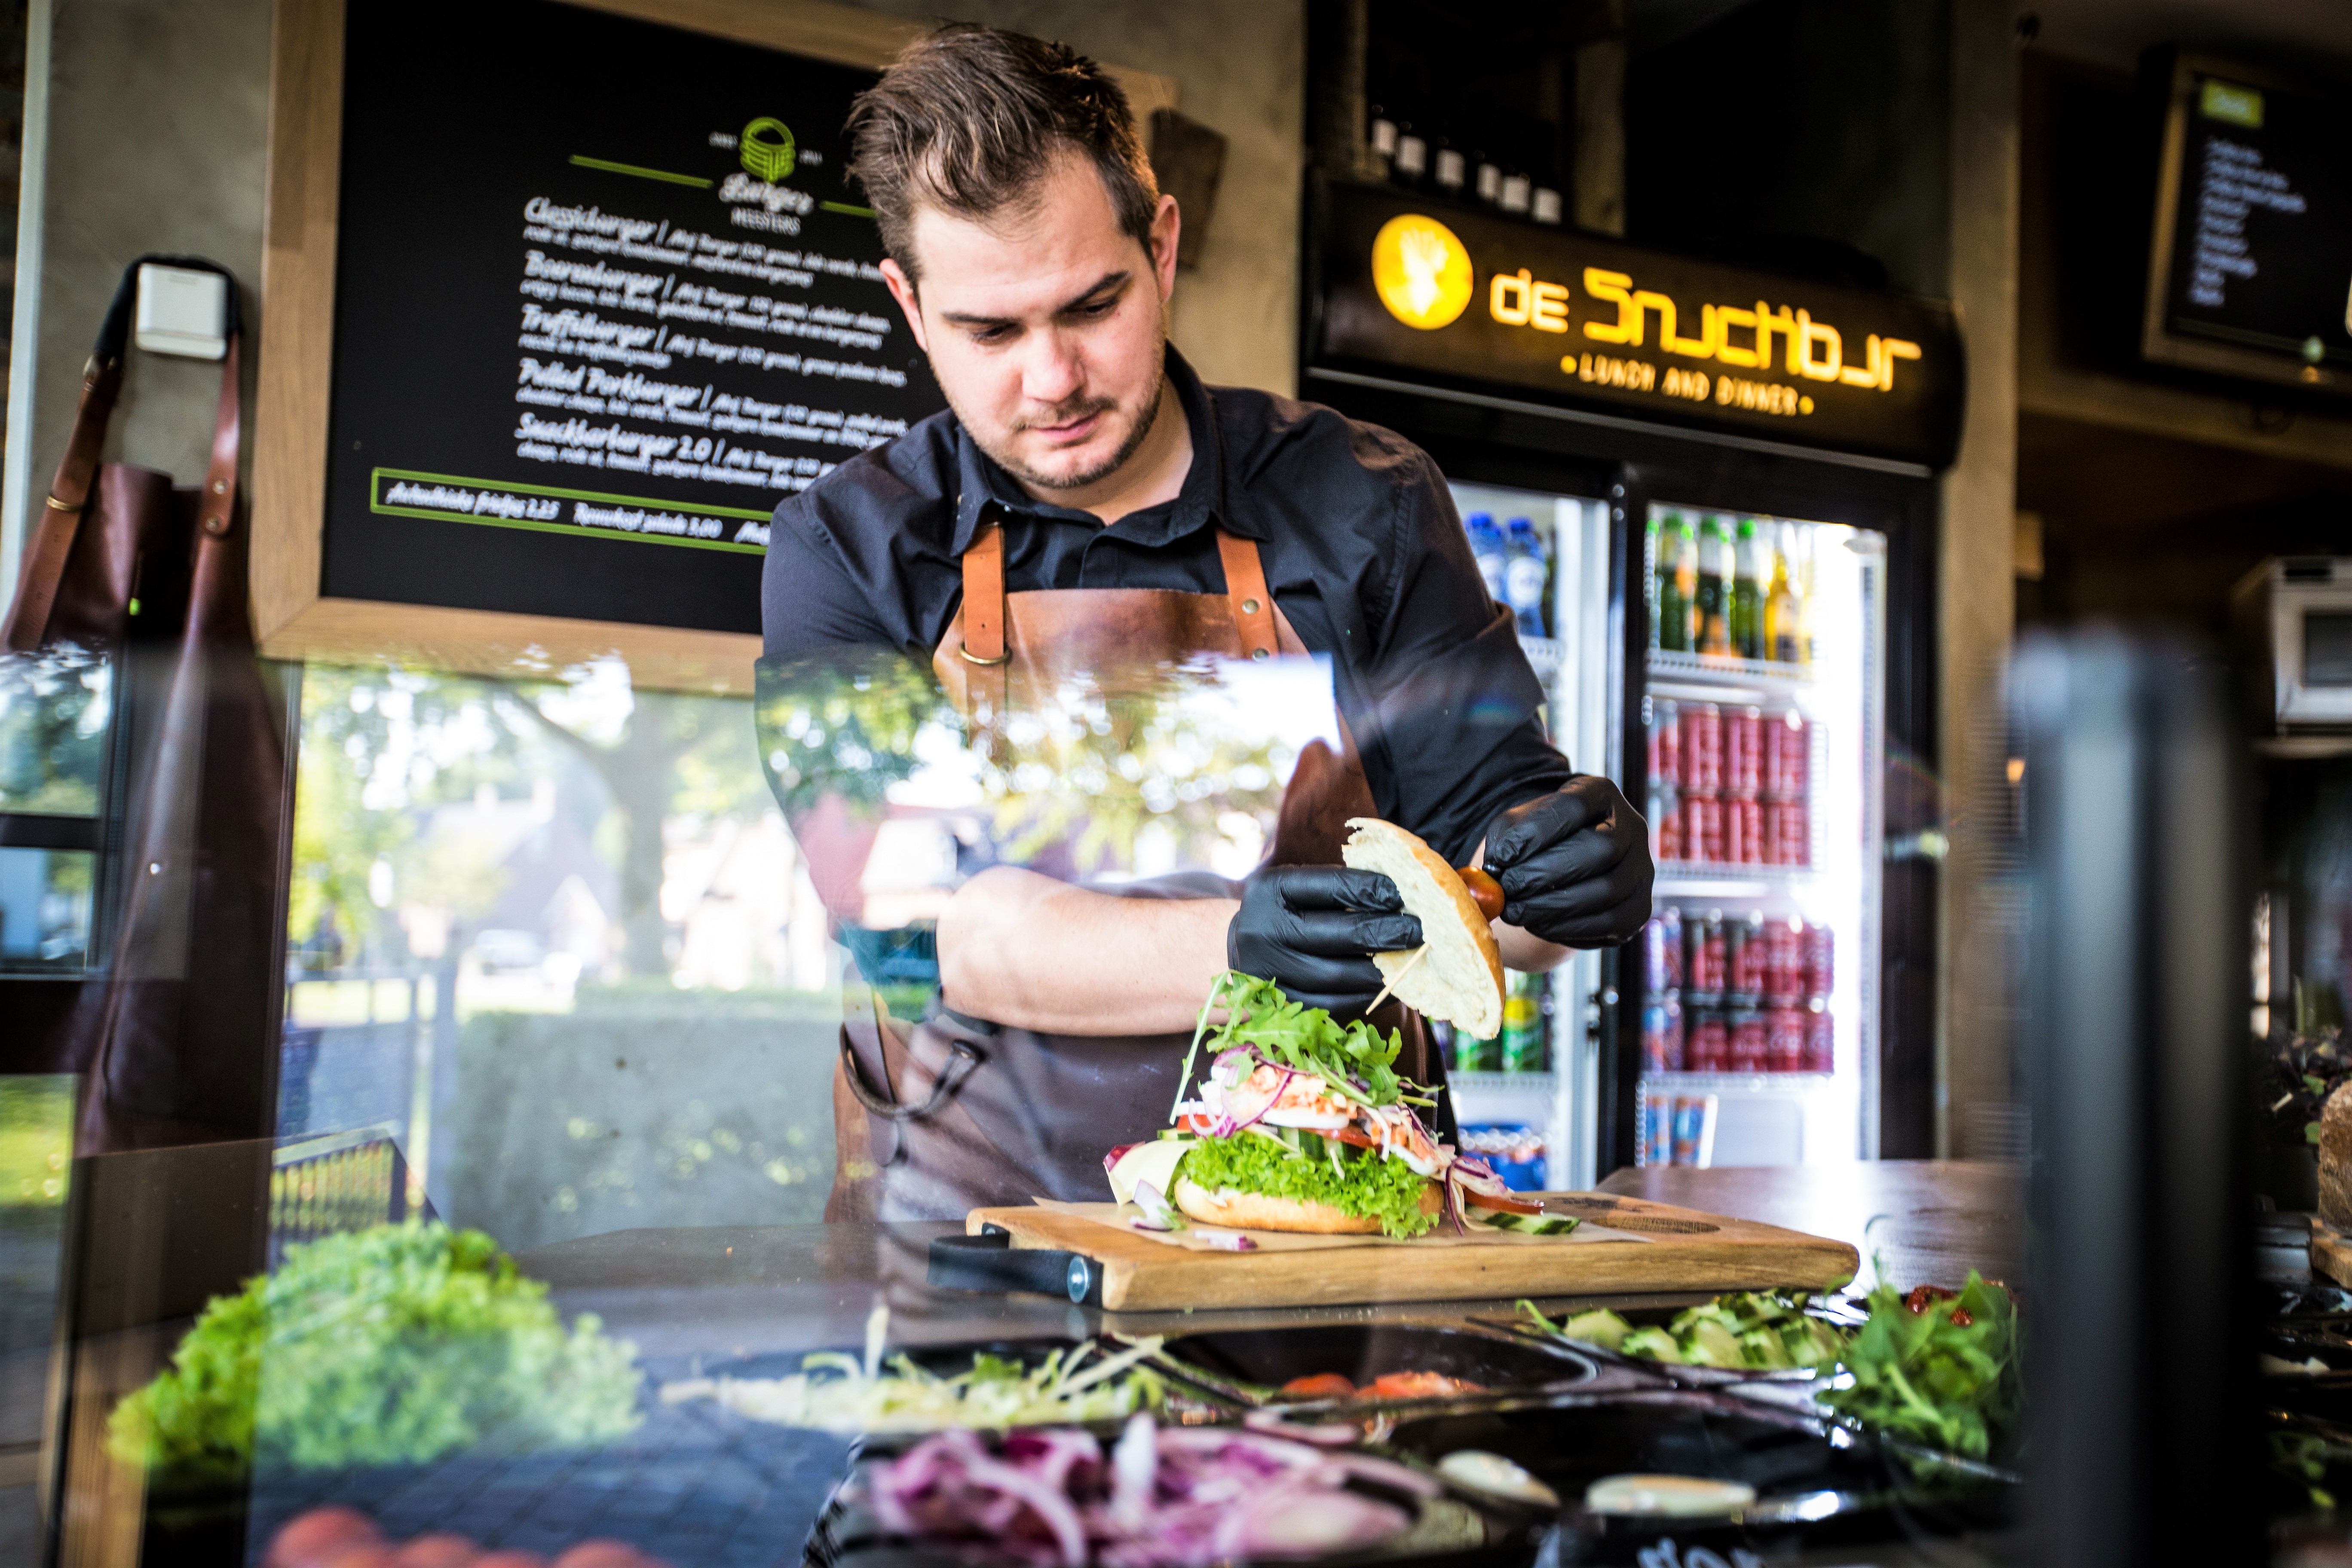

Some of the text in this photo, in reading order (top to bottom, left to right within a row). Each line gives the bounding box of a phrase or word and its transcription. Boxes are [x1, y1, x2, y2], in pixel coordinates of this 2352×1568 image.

[525, 197, 657, 245] Classicburger
[731, 207, 801, 236] MEESTERS
[525, 250, 664, 299] Boerenburger
[1490, 268, 1569, 334] de
[521, 303, 656, 353] Truffelburger
[518, 357, 586, 393] Pulled
[586, 367, 701, 413] Porkburger
[1579, 352, 1799, 417] LUNCH AND DINNER
[514, 412, 678, 463] Snackbarburger
[676, 435, 712, 464] 2.0
